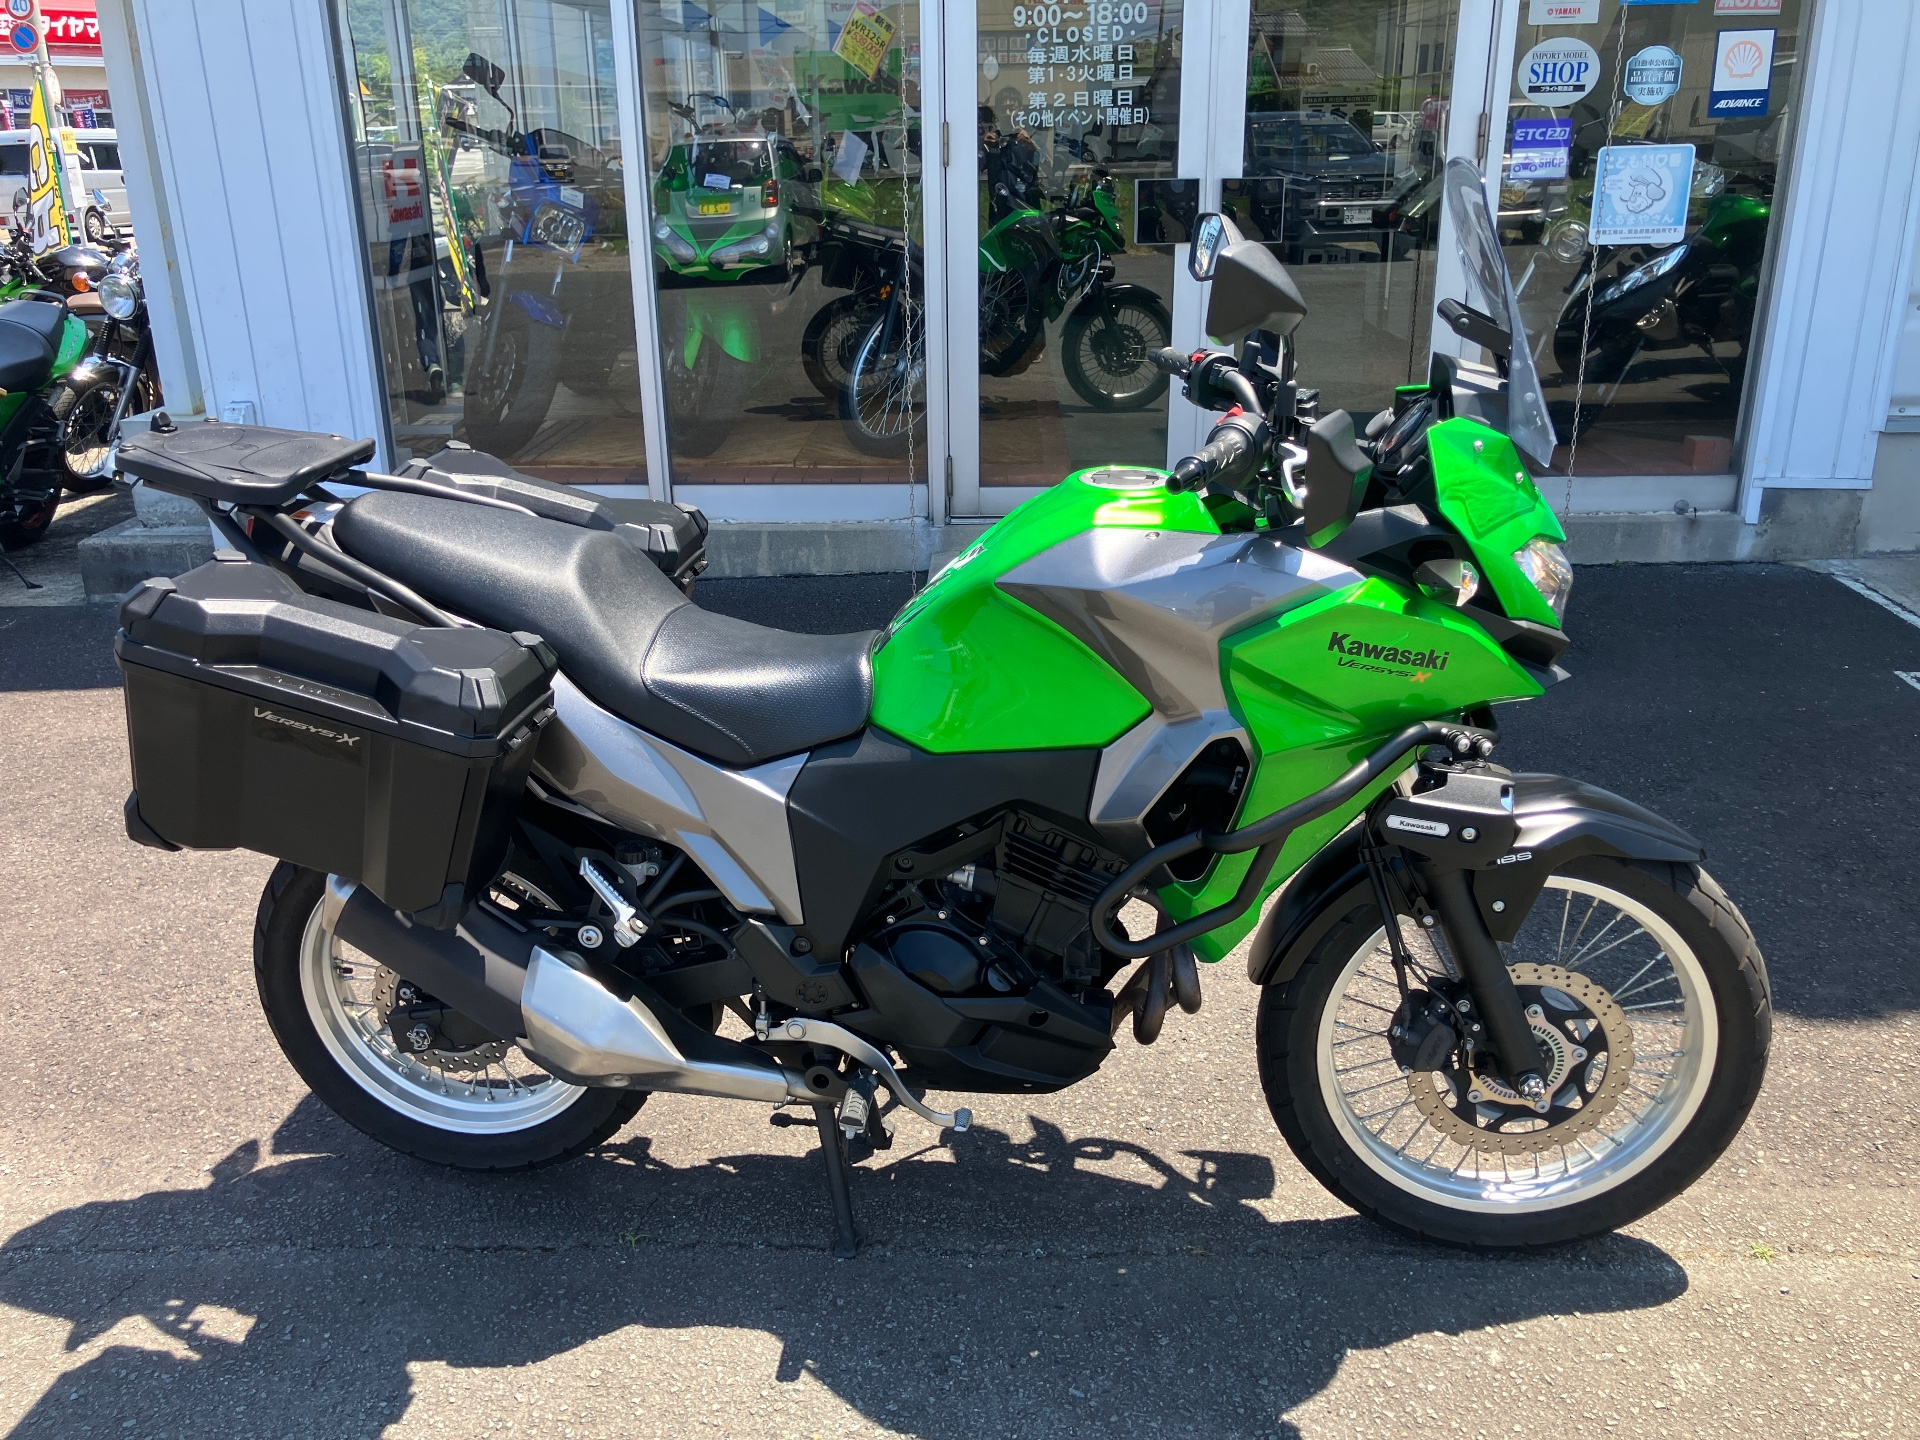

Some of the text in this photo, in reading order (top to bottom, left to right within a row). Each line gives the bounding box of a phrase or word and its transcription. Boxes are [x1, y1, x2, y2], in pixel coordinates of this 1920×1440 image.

[13, 0, 27, 12] 40
[1555, 7, 1581, 15] YAMAHA
[851, 18, 887, 51] WR125R
[1027, 44, 1133, 65] 毎週水曜日
[1562, 51, 1589, 59] MODEL
[1528, 61, 1589, 84] SHOP
[1637, 86, 1664, 96] 実施店
[1713, 98, 1764, 109] ADVANCE
[1538, 158, 1565, 168] SHOP
[1327, 631, 1450, 671] Kawasaki
[1337, 656, 1433, 683] VERSYS-X
[254, 706, 361, 747] VERSYS-X
[1399, 819, 1437, 832] Kawasaki
[1496, 851, 1532, 865] BS
